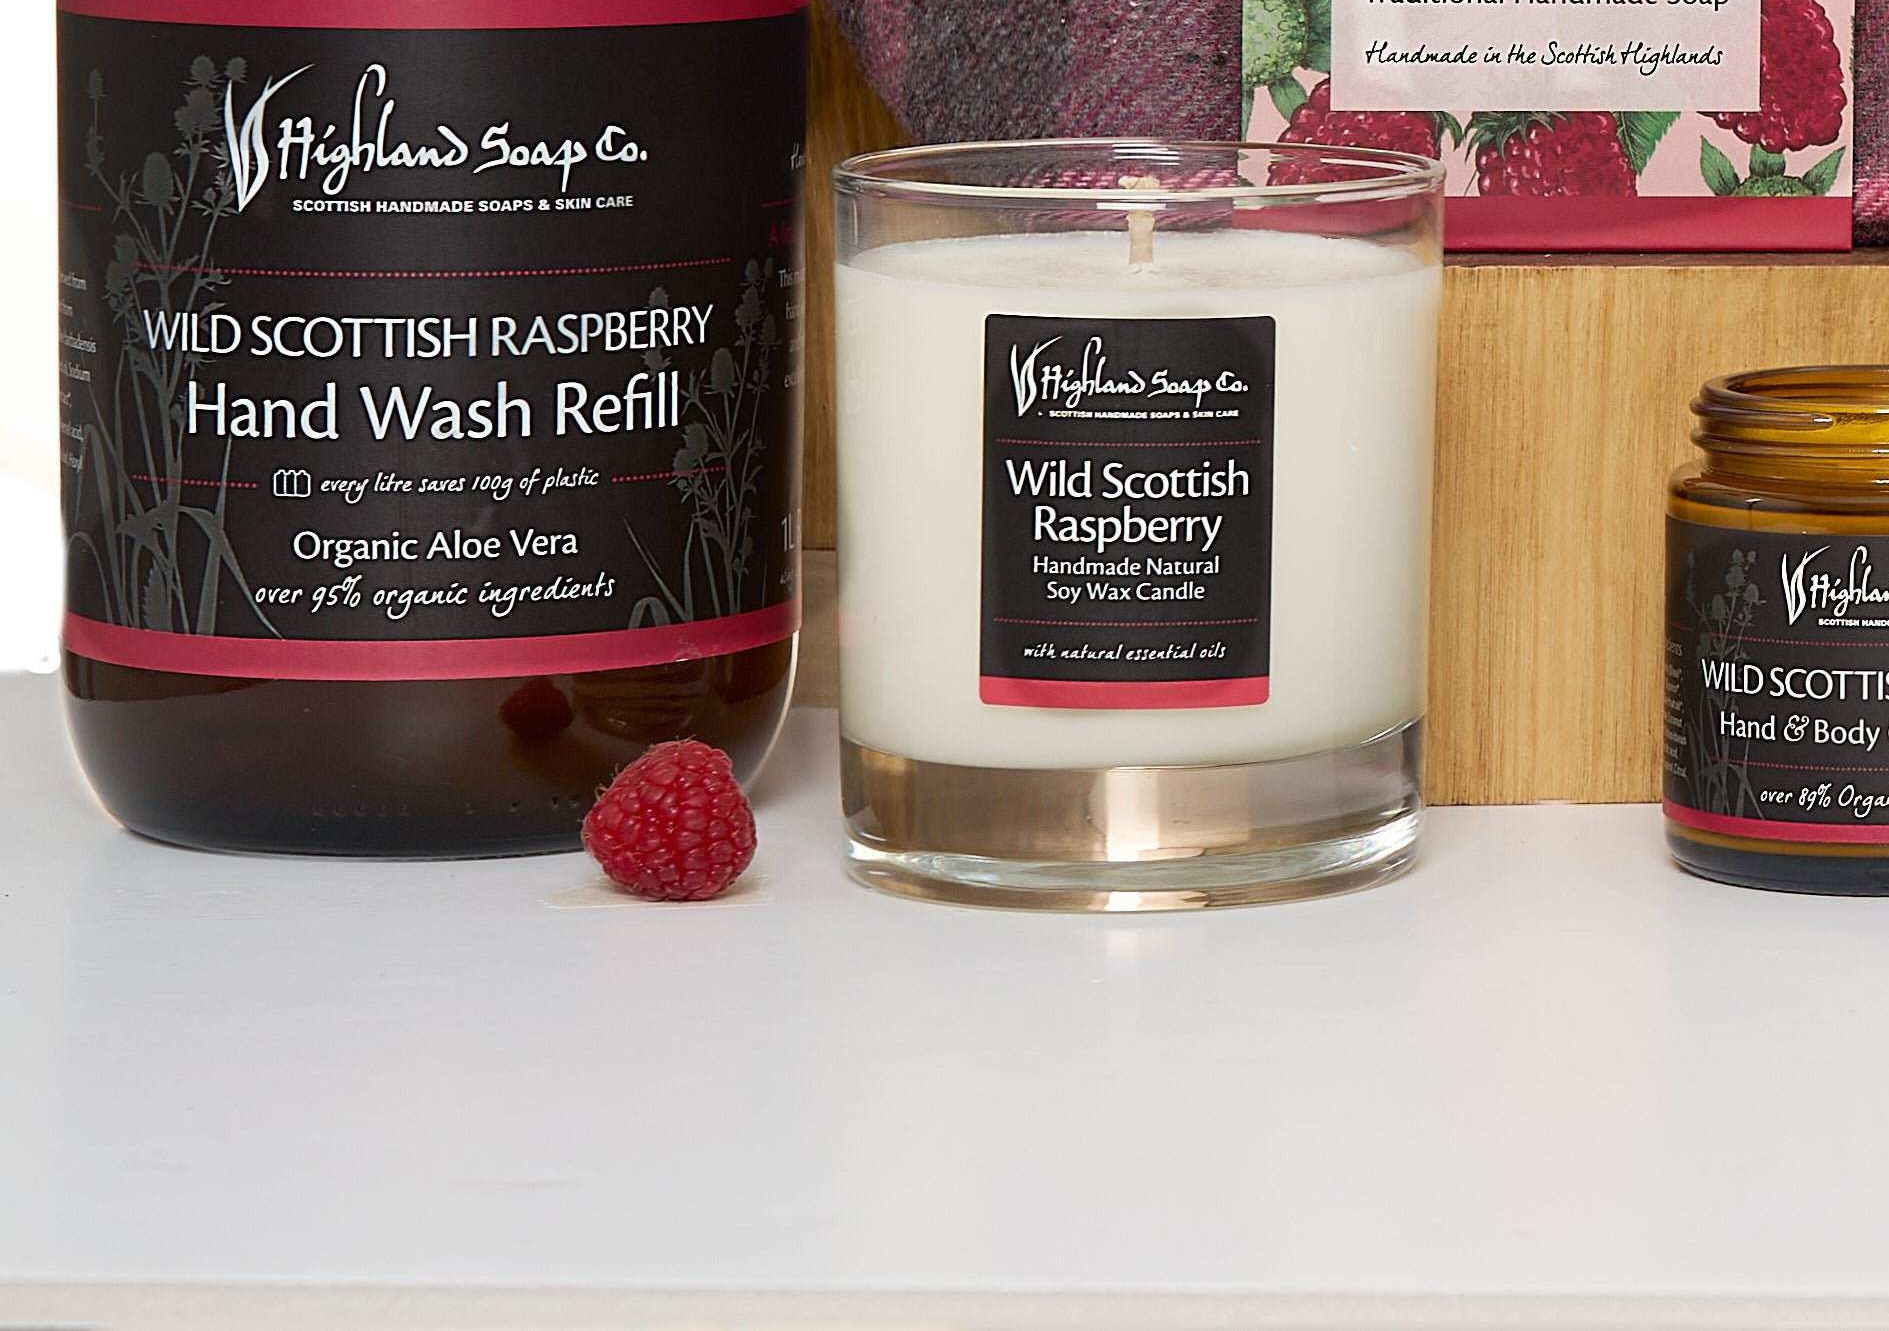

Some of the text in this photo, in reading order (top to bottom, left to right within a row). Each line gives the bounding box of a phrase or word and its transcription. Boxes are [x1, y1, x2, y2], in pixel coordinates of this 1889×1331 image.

[1365, 40, 1724, 77] Handmade in the Scottish Highlands
[277, 63, 648, 196] Highland Soap Co.
[292, 195, 633, 213] SCOTTISH HANDMADE SOAPS & SKIN CARE
[143, 309, 242, 354] WILD
[250, 315, 477, 358] SCOTTISH
[491, 304, 714, 357] RASPBERRY
[1040, 336, 1249, 409] Highland Soap Co.
[188, 370, 679, 441] Hand Wash Refill
[320, 466, 600, 505] every litre saves 100g of plastic
[1005, 458, 1249, 499] Wild Scottish
[293, 528, 579, 569] Organic Aloe Vera
[1034, 505, 1223, 554] Raspberry
[1033, 555, 1220, 576] Handmade Natural
[255, 571, 615, 620] over 95% organic ingredients
[1047, 580, 1205, 605] Soy Wax Candle
[1023, 641, 1226, 661] with natural essential oils
[1720, 710, 1776, 741] Hand
[1783, 714, 1810, 742] &
[1814, 718, 1881, 752] Body
[1760, 790, 1793, 804] over
[1798, 782, 1833, 811] 89%
